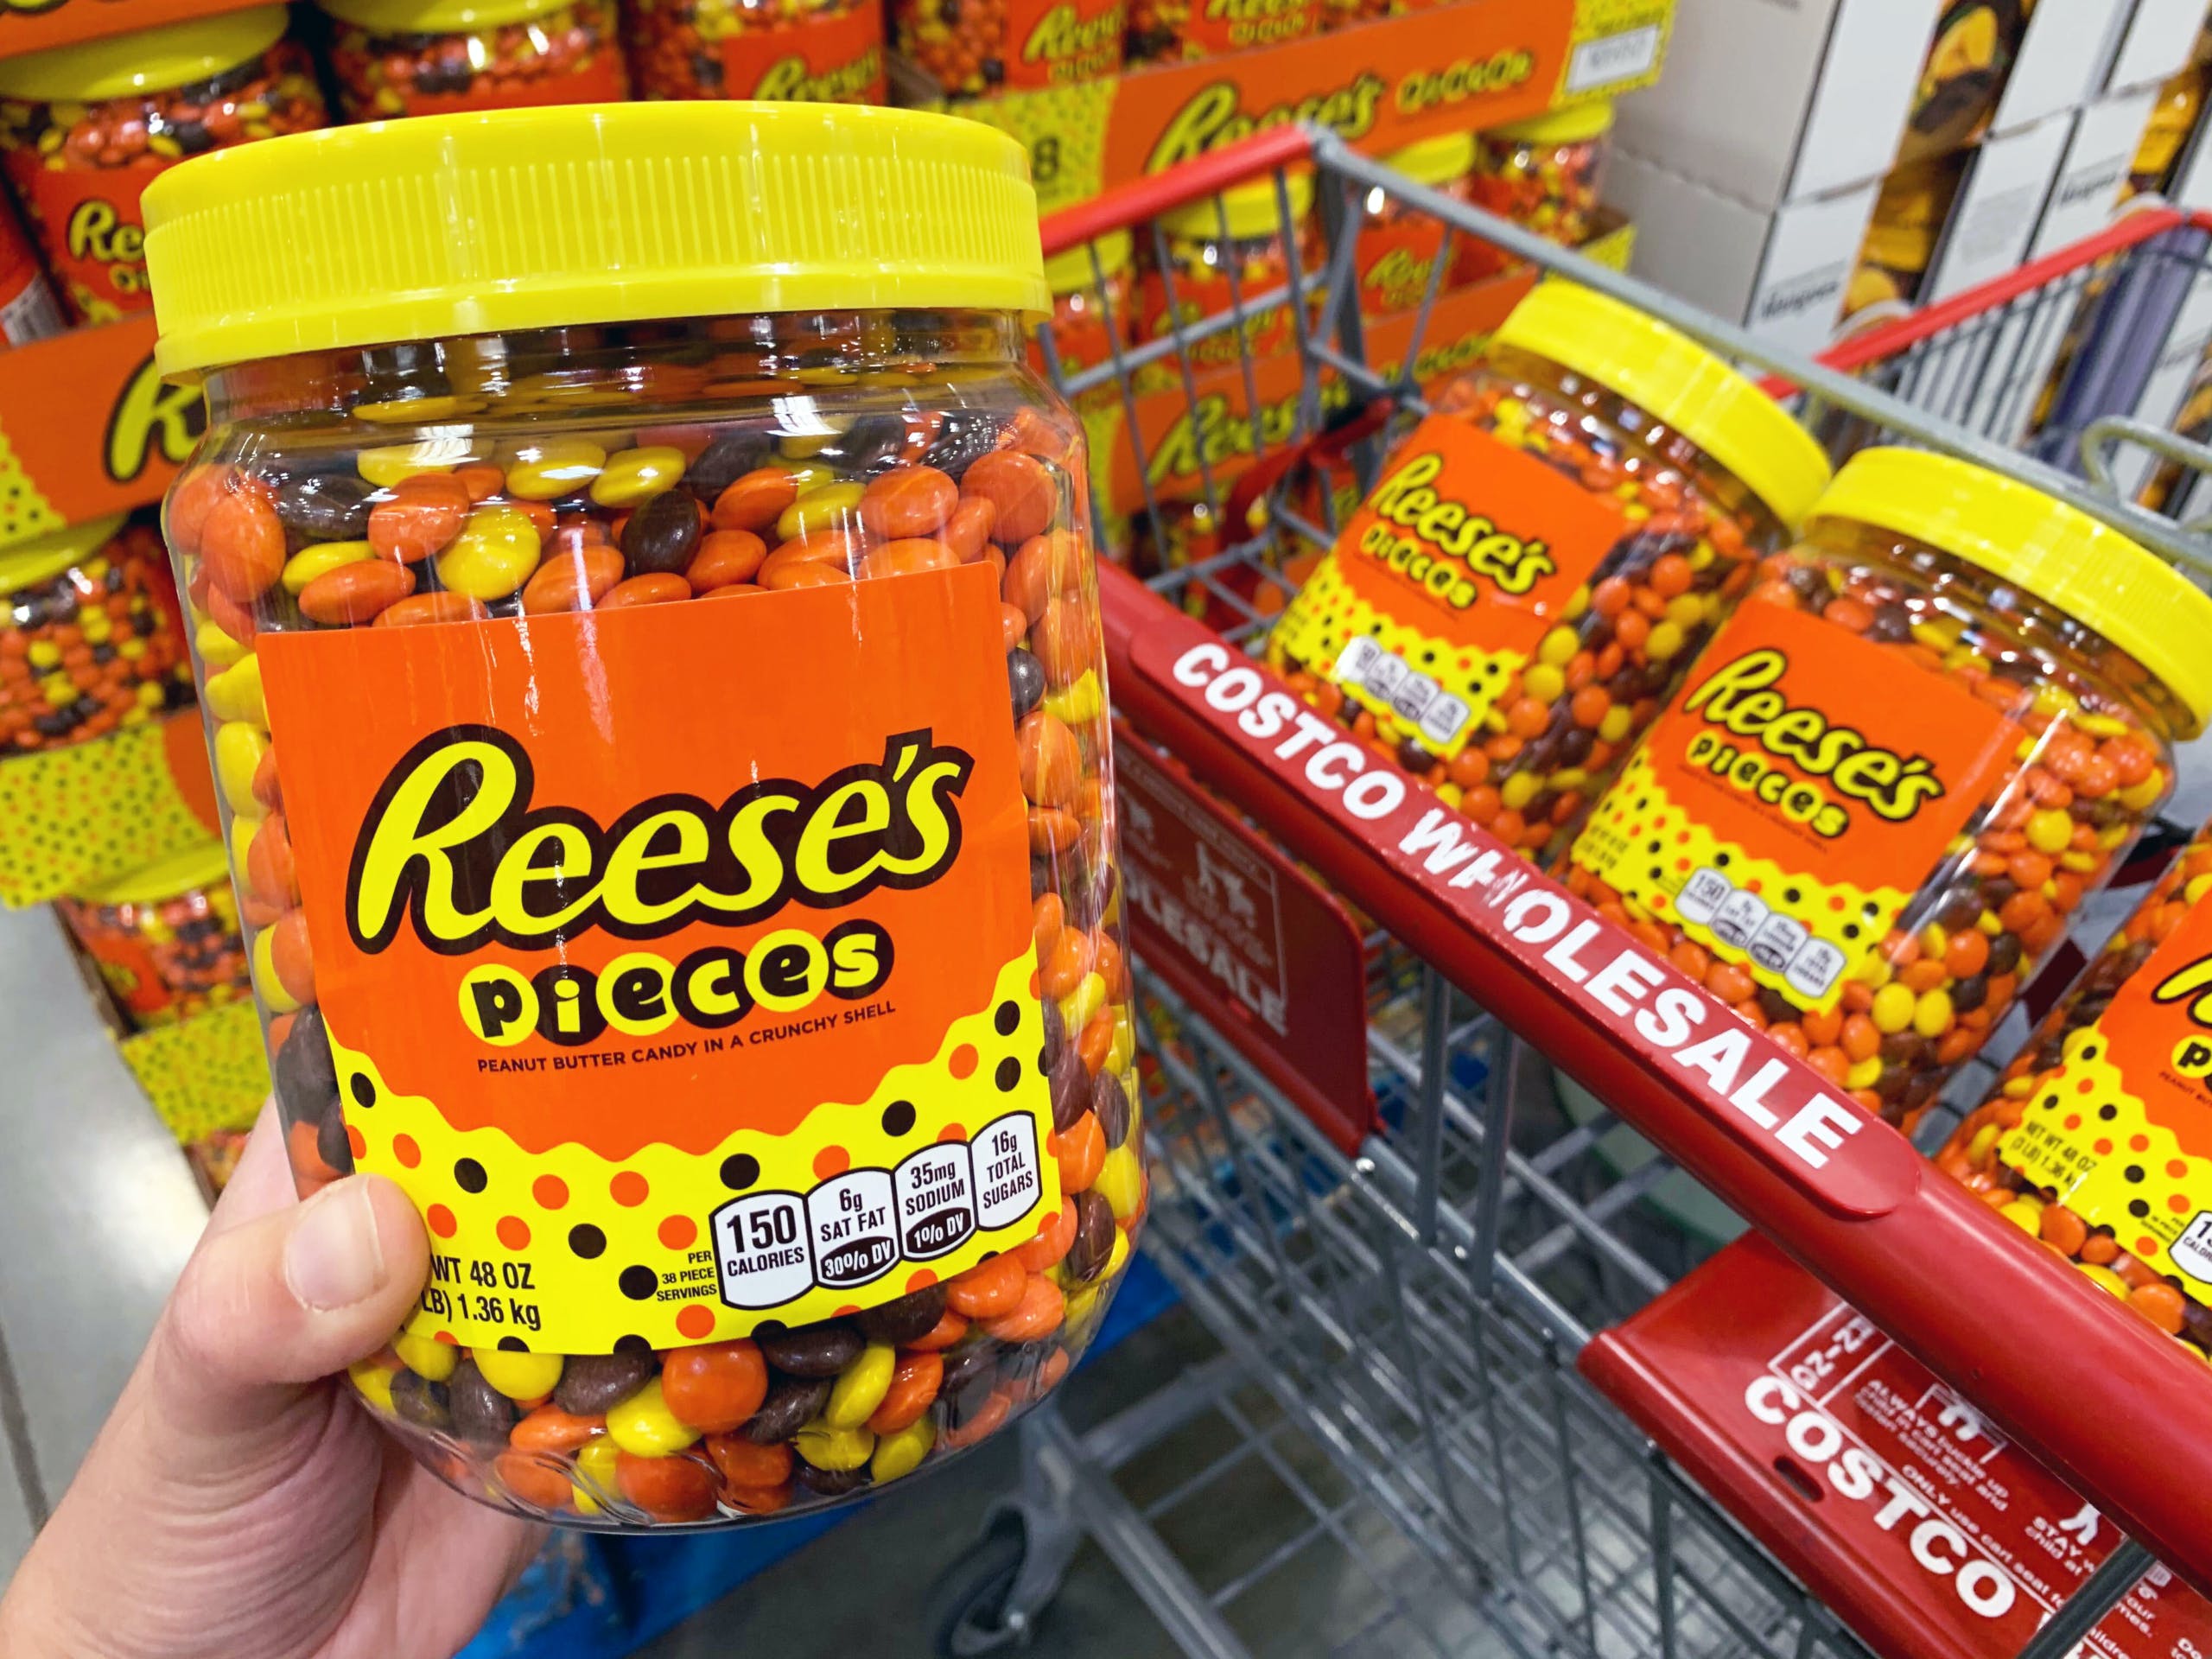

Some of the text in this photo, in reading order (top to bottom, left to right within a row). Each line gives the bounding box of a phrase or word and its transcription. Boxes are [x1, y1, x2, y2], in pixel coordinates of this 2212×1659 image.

[1369, 452, 1557, 594] Reese's
[1681, 647, 1945, 823] Reese's
[1686, 728, 1850, 839] pieces
[346, 725, 974, 955] Reese's
[1173, 643, 1406, 819] COSTCO
[1399, 808, 1863, 1169] WHOLESALE
[459, 919, 893, 1046] pieces
[478, 1001, 896, 1072] PEANUT BUTTER CANDY IN A CRUNCHY SHELL
[991, 1130, 1017, 1156] 16g
[910, 1161, 956, 1189] 35mg
[986, 1152, 1026, 1183] TOTAL
[839, 1188, 863, 1212] 6g
[906, 1179, 965, 1216] SODIUM
[982, 1170, 1033, 1209] SUGARS
[726, 1205, 797, 1254] 150
[821, 1206, 886, 1242] SAT FAT
[913, 1212, 964, 1249] 1% DV
[430, 1255, 536, 1289] WT 48 OZ
[688, 1250, 712, 1264] PER
[727, 1247, 804, 1276] CALORIES
[824, 1239, 891, 1278] 30% DV
[657, 1284, 717, 1302] SERVINGS
[662, 1267, 715, 1285] 38 PIECE
[457, 1294, 505, 1324] 1.36
[510, 1298, 541, 1332] kg
[1868, 1380, 1938, 1439] ALWAYS
[1745, 1375, 2017, 1618] COSTCO
[1975, 1484, 2008, 1512] and
[1903, 1464, 1951, 1505] ONLY
[1950, 1507, 1980, 1534] use
[1980, 1533, 2012, 1563] cart
[2013, 1561, 2050, 1596] seat
[2024, 1526, 2064, 1560] child
[2033, 1516, 2082, 1557] STAY
[2126, 1596, 2156, 1621] our
